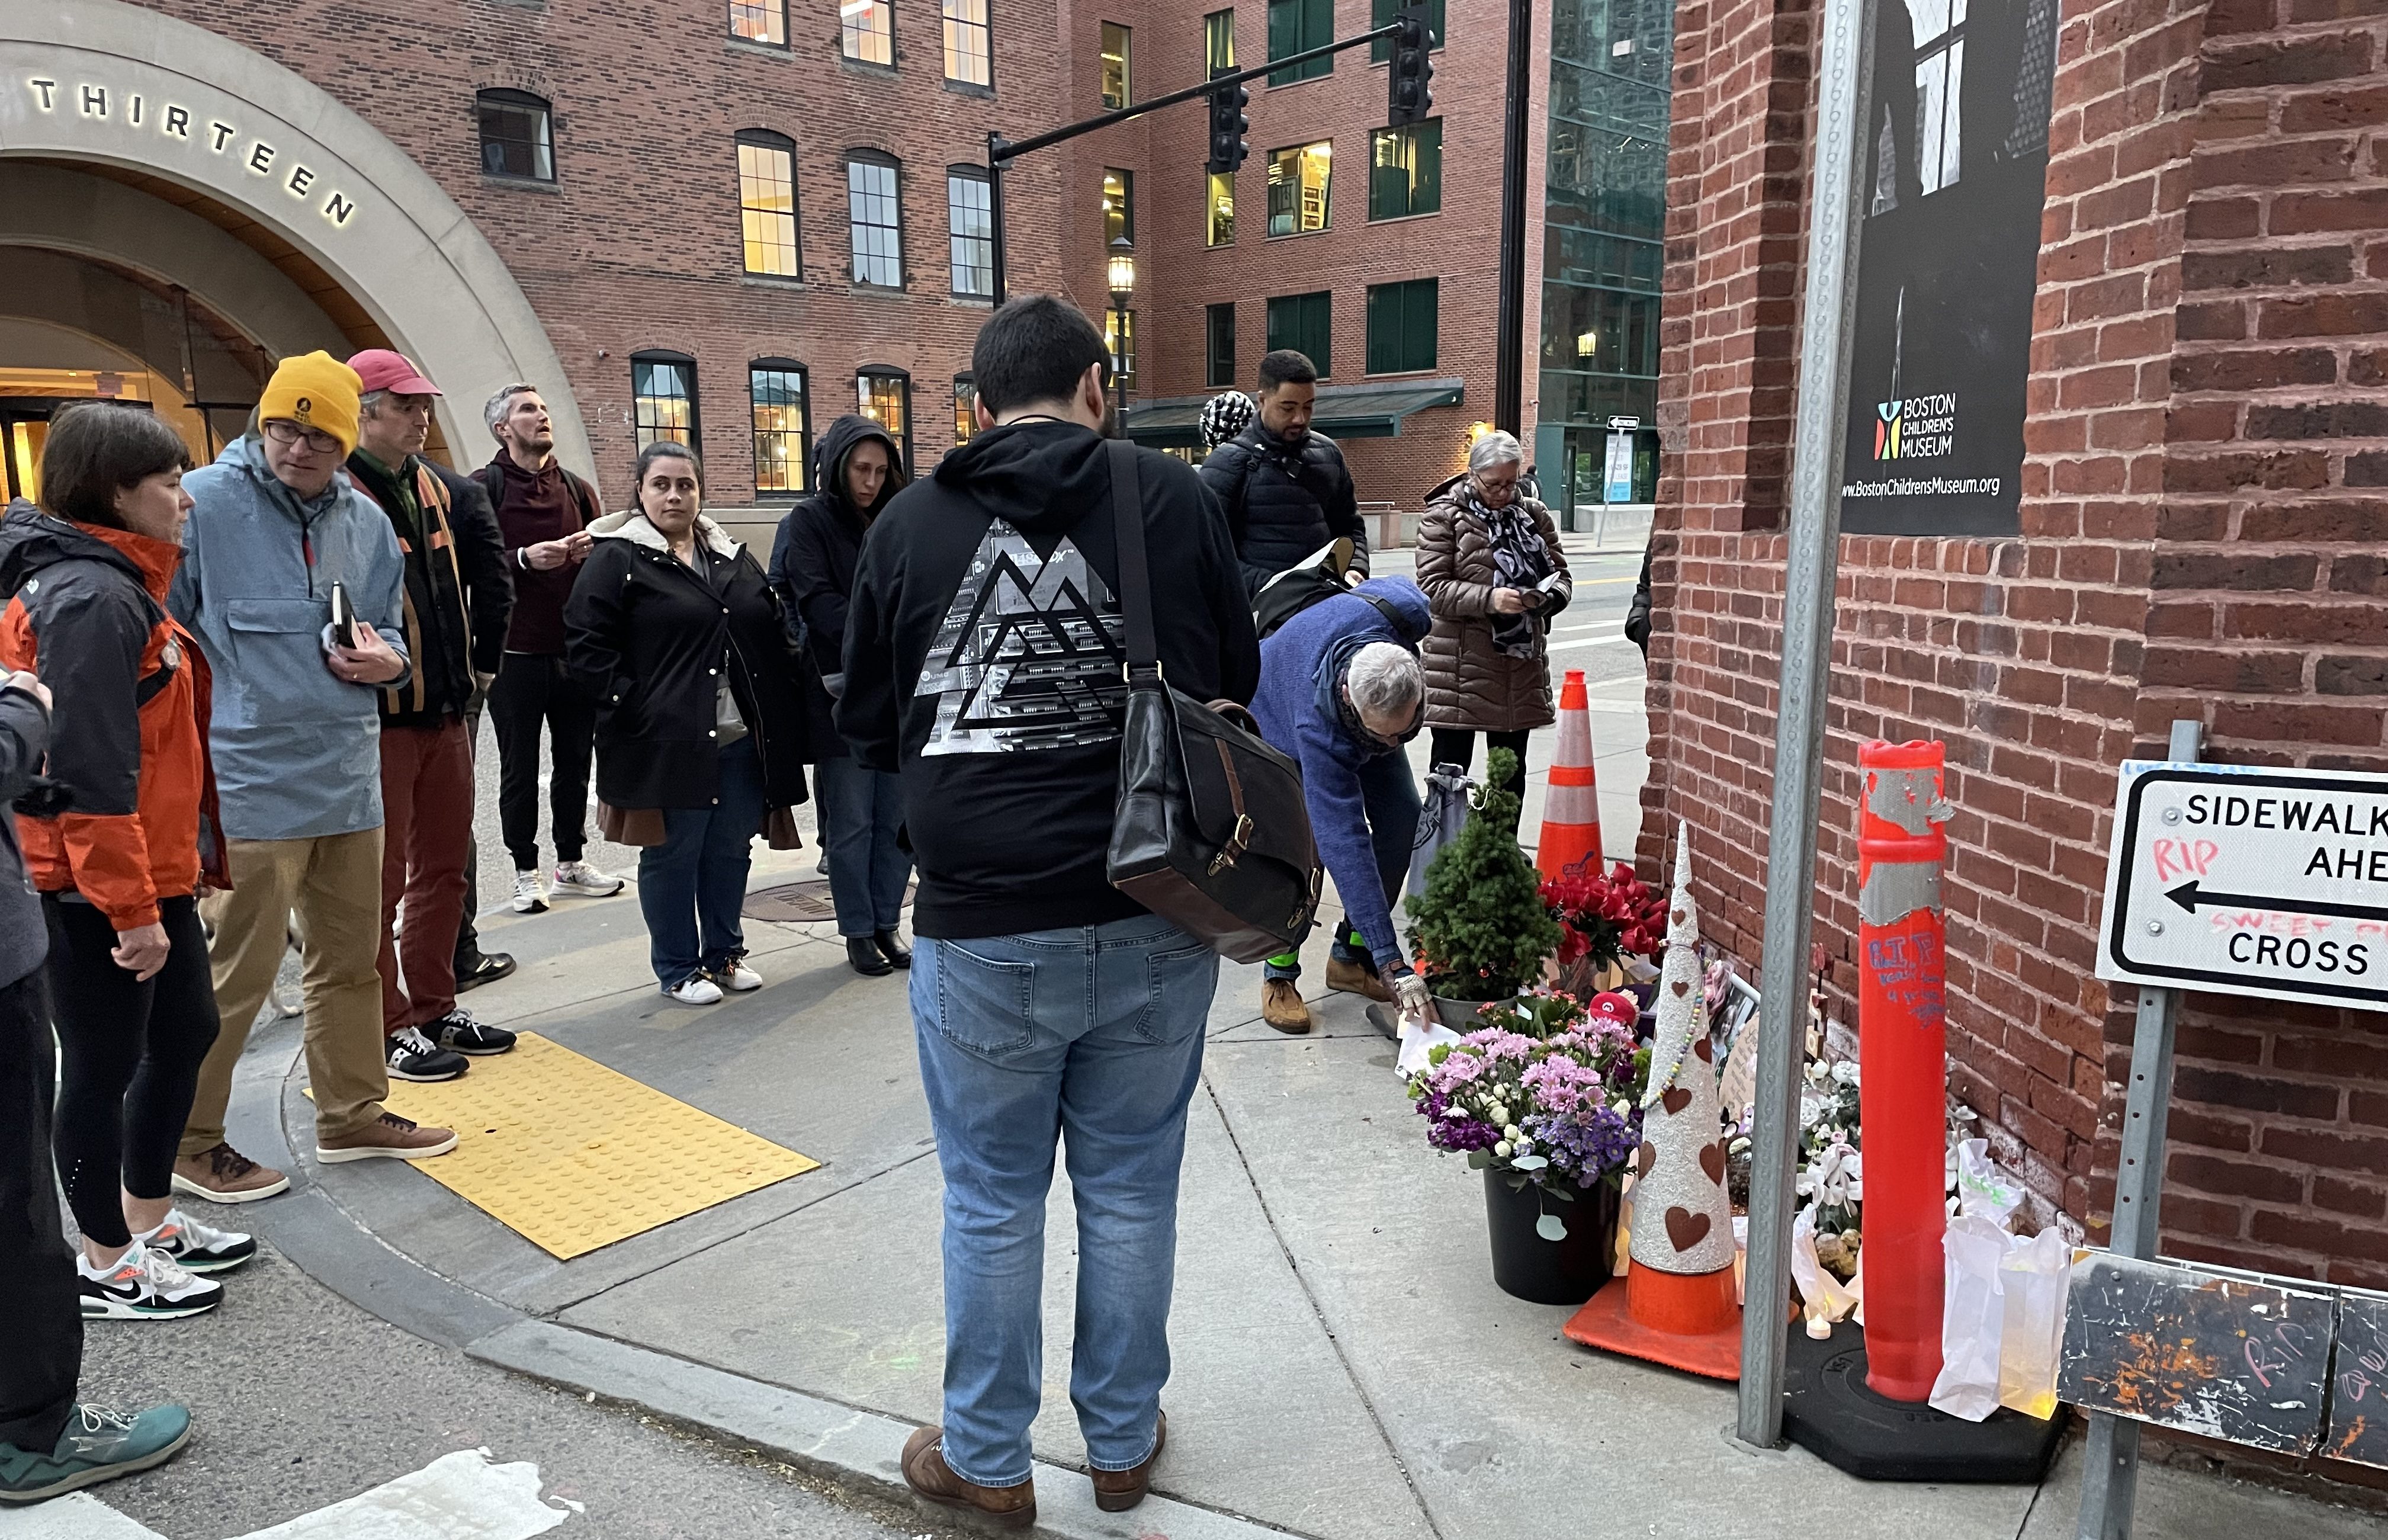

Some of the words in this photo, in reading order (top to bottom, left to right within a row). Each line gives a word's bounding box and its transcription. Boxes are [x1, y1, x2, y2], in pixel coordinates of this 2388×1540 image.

[31, 80, 355, 224] THIRTEEN
[1904, 392, 1956, 419] BOSTON
[1902, 417, 1954, 436] CHILDREN'S
[1900, 435, 1953, 458] MUSEUM
[2185, 794, 2388, 836] SIDEWALK
[2152, 836, 2219, 882] RIP
[2210, 911, 2332, 938] SWEET
[2229, 932, 2368, 975] CROSS
